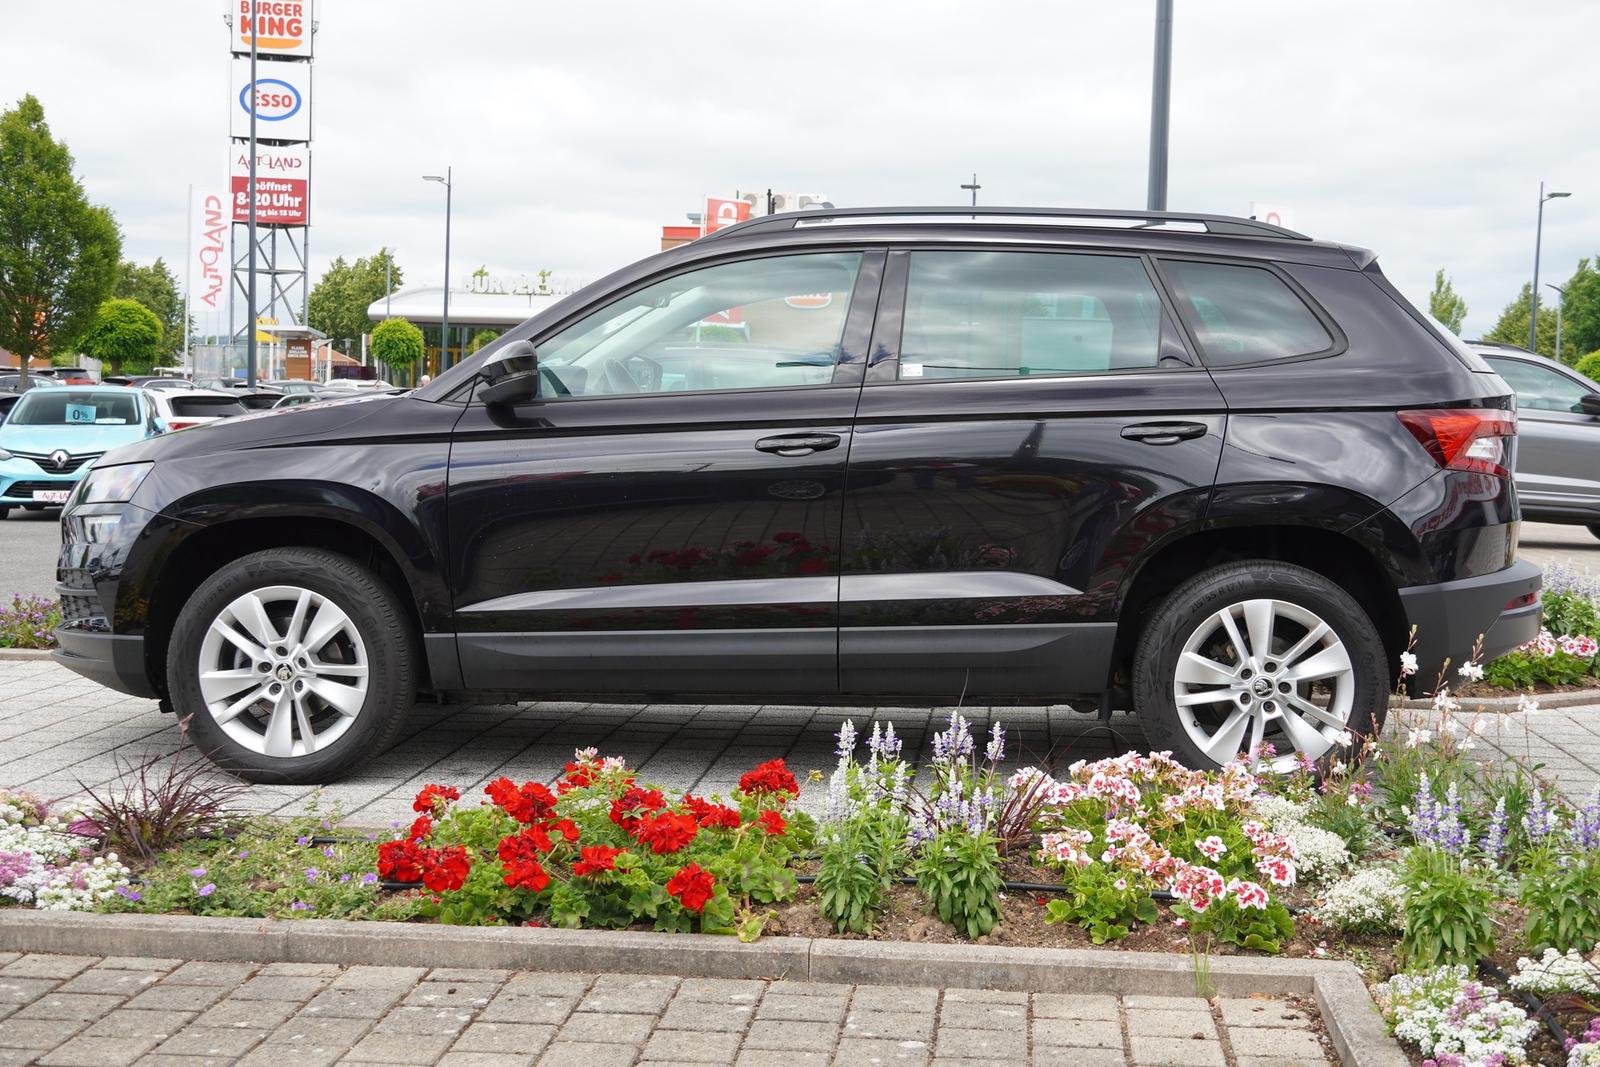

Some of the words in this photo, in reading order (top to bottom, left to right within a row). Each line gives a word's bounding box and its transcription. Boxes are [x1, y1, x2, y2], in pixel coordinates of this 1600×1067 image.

[240, 15, 303, 37] KING
[238, 154, 302, 171] ATOLAND
[272, 193, 303, 208] Uhr
[267, 209, 279, 217] bis
[288, 209, 302, 217] Uhr
